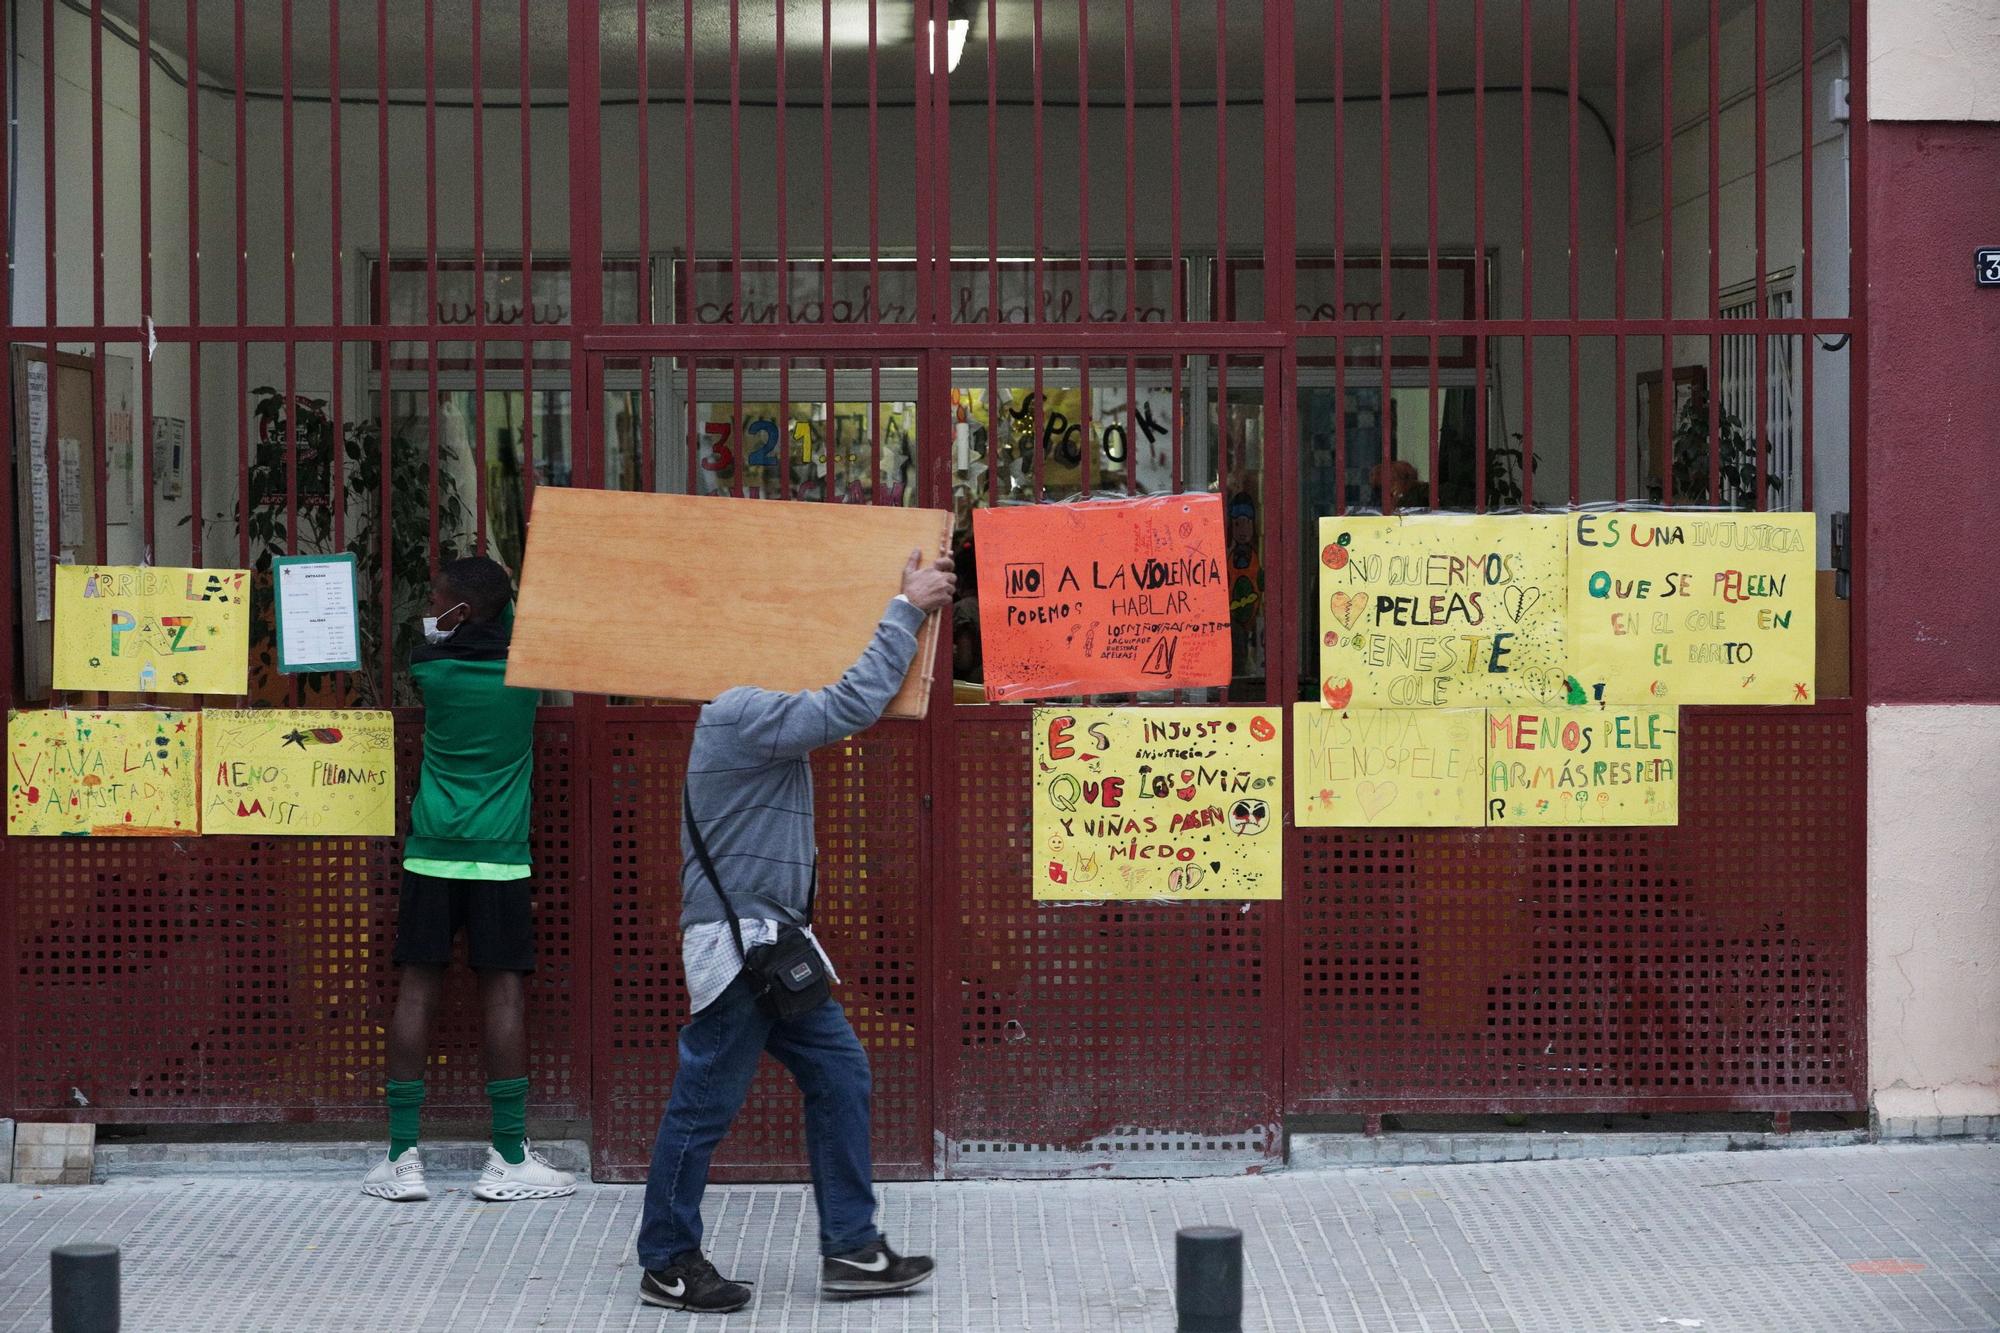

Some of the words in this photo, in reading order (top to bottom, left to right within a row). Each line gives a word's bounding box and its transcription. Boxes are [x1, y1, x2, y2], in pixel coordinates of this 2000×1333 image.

[1577, 514, 1620, 548] ES
[1630, 523, 1684, 548] UNA
[1691, 521, 1805, 552] INJUSTICIA
[84, 573, 175, 599] ARRIBA
[1011, 568, 1042, 595] NO
[1058, 566, 1080, 593] A
[1349, 554, 1383, 585] NO
[1588, 570, 1652, 600] QUE
[1660, 572, 1693, 598] SE
[1712, 569, 1787, 604] PELEEN
[1008, 602, 1083, 627] PODEMOS
[1112, 591, 1191, 616] HABLAR
[1376, 592, 1484, 627] PELEAS
[1611, 612, 1640, 636] EN
[1652, 611, 1674, 634] EL
[1684, 609, 1728, 631] COLE
[1757, 608, 1792, 630] EN
[111, 609, 207, 658] PAZ
[1653, 642, 1672, 667] EL
[1388, 675, 1453, 706] COLE
[1048, 715, 1111, 760] ES
[1490, 714, 1593, 754] MENOS
[12, 748, 105, 787] VIVA
[217, 761, 289, 787] MENOS
[1048, 773, 1125, 812] QUE
[206, 794, 322, 827] AMISTAD
[1060, 818, 1074, 836] Y
[1084, 814, 1157, 837] NIÑAS
[1489, 798, 1506, 821] R
